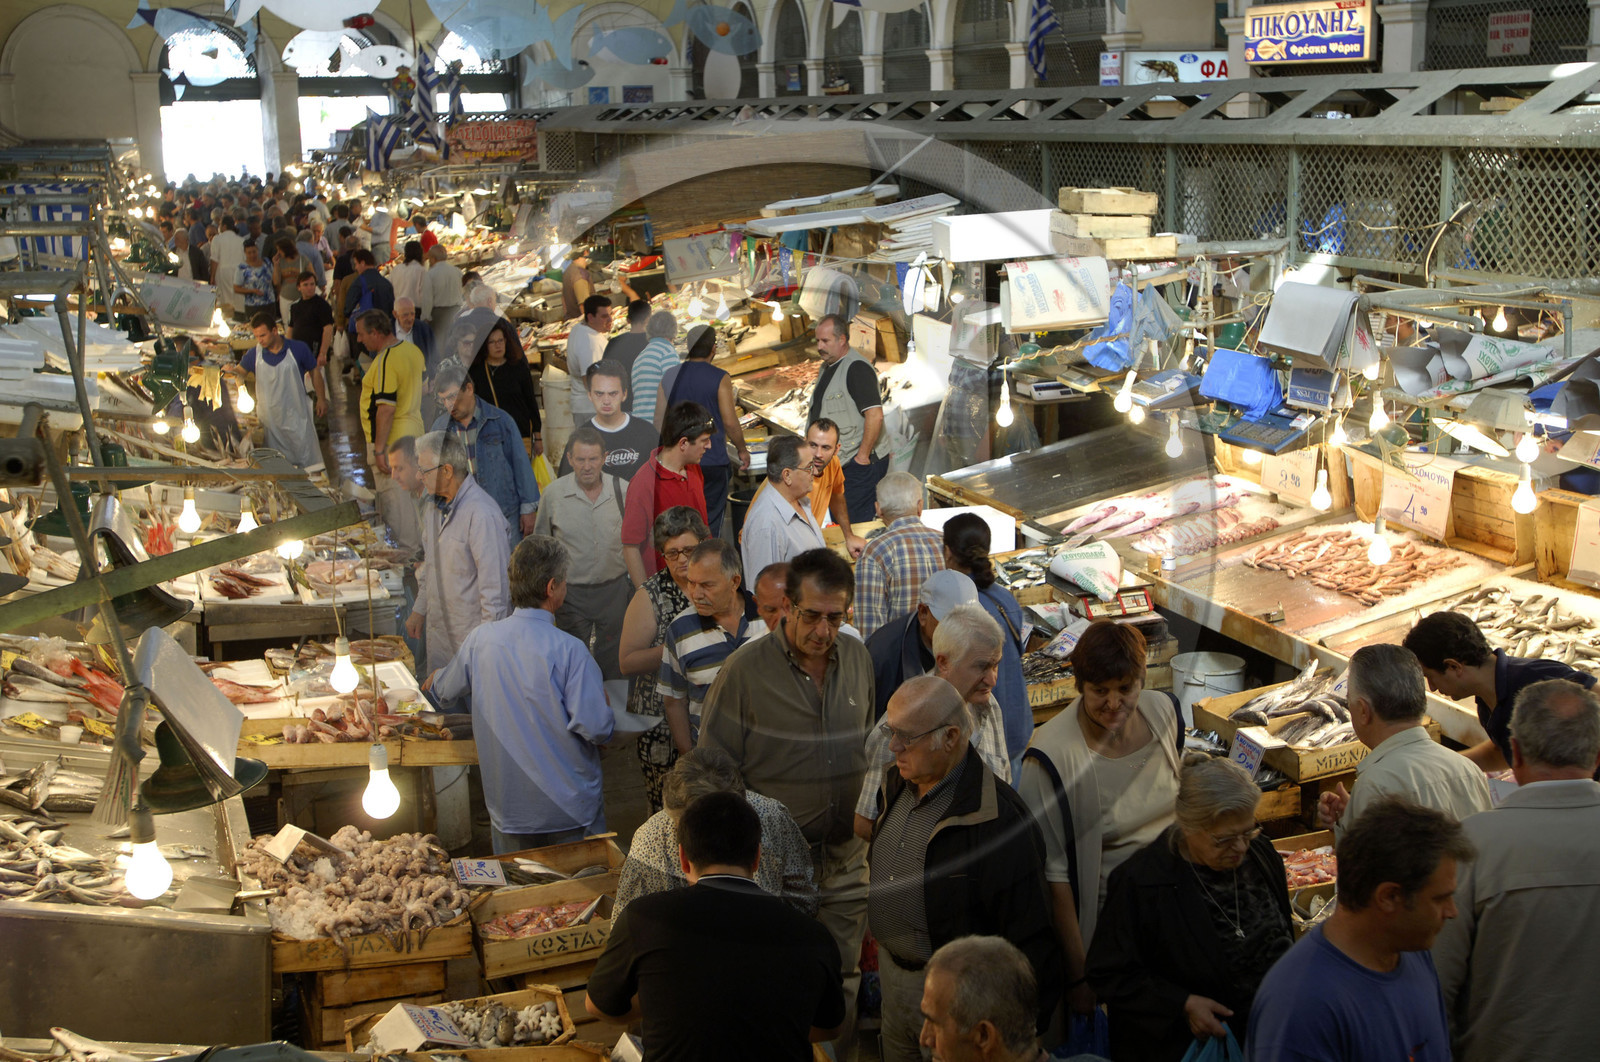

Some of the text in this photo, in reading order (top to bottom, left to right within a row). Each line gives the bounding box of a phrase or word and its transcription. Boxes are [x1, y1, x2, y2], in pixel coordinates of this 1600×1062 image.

[1252, 9, 1358, 38] ΠΙΚΟΥΝΗΣ
[1290, 42, 1360, 57] Φρέσκα Ψάρια
[605, 452, 640, 464] EISURE
